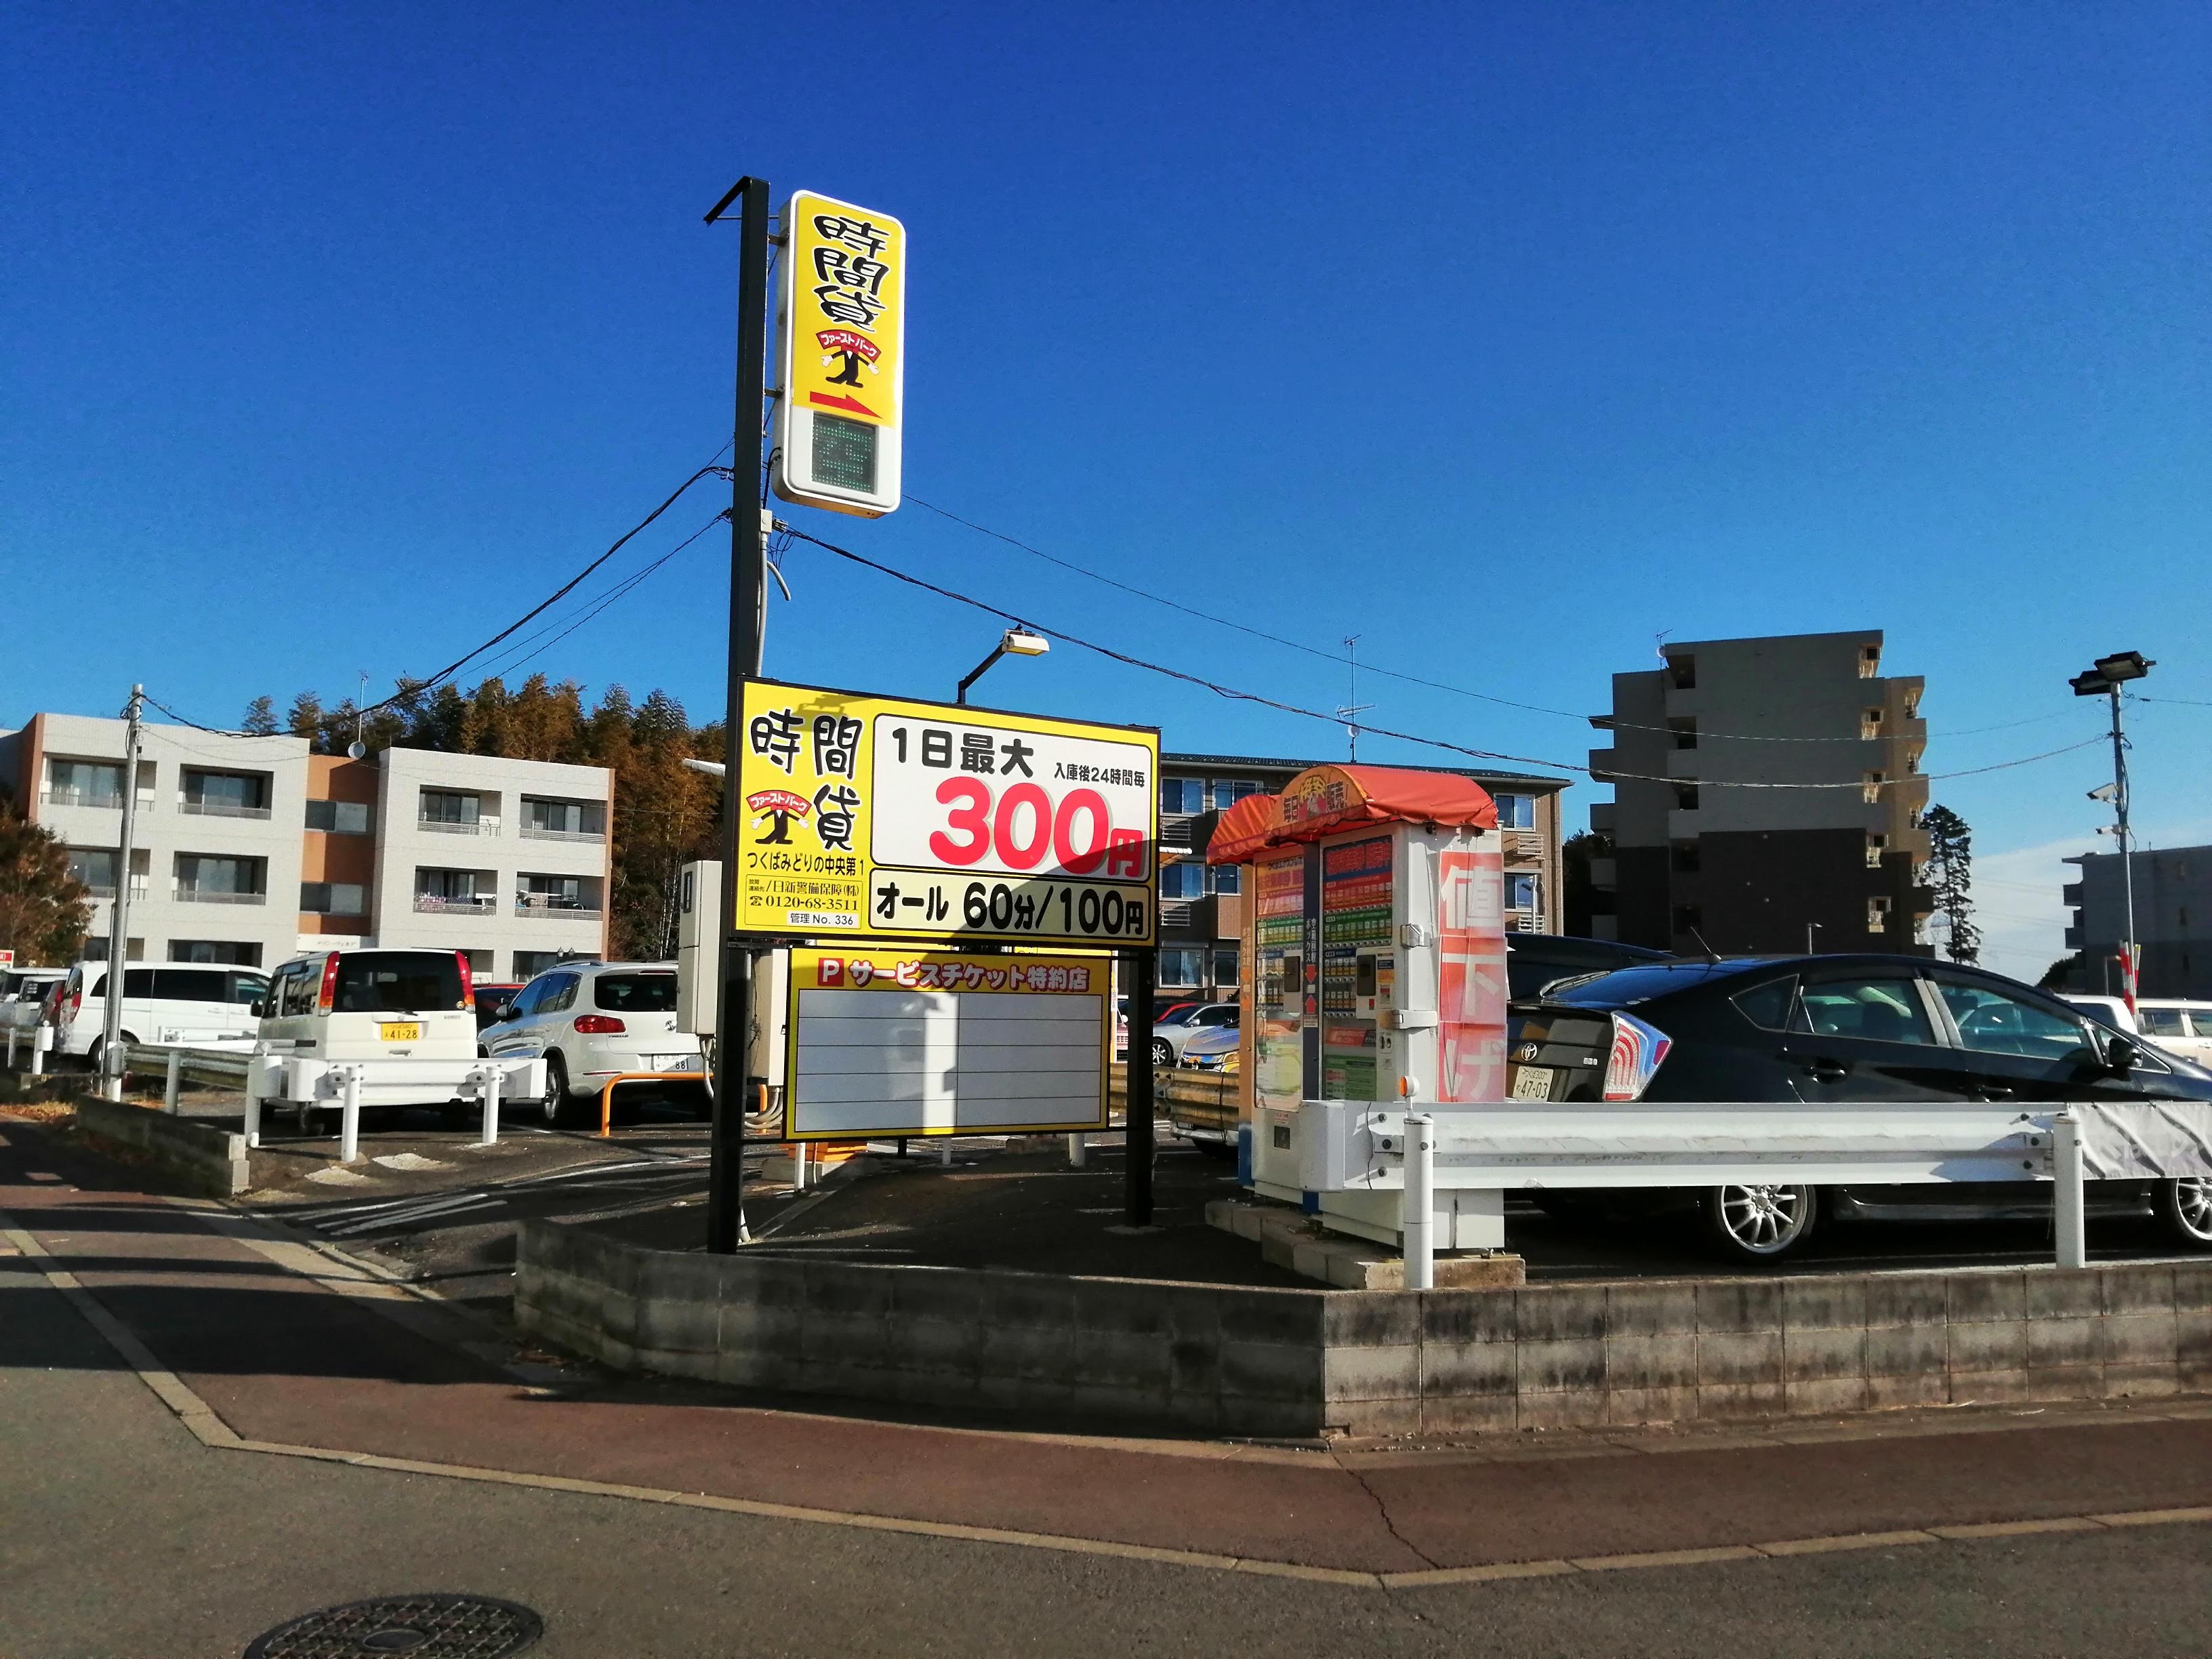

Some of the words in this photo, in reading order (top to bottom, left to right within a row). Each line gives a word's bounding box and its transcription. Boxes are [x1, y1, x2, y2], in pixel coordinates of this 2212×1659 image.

[813, 216, 889, 332] 時間貸
[820, 333, 878, 357] ファーストパーク
[751, 709, 863, 780] 時間
[892, 727, 1034, 778] 1日最大
[1054, 762, 1145, 788] 入庫後24時間毎
[750, 792, 808, 811] ファーストパーク
[813, 784, 861, 851] 貸
[929, 776, 1145, 878] 300円
[766, 895, 857, 911] 0120-68-3511
[876, 882, 949, 922] オール
[963, 882, 1144, 935] 60分/100円
[790, 913, 810, 924] 管理
[813, 915, 831, 924] No.
[835, 916, 853, 925] 336
[822, 960, 840, 983] P
[849, 960, 1090, 991] サービスチケット特約店
[1440, 865, 1506, 1101] 値下げ
[390, 1029, 417, 1039] 41-28
[1521, 1080, 1549, 1099] 47-03
